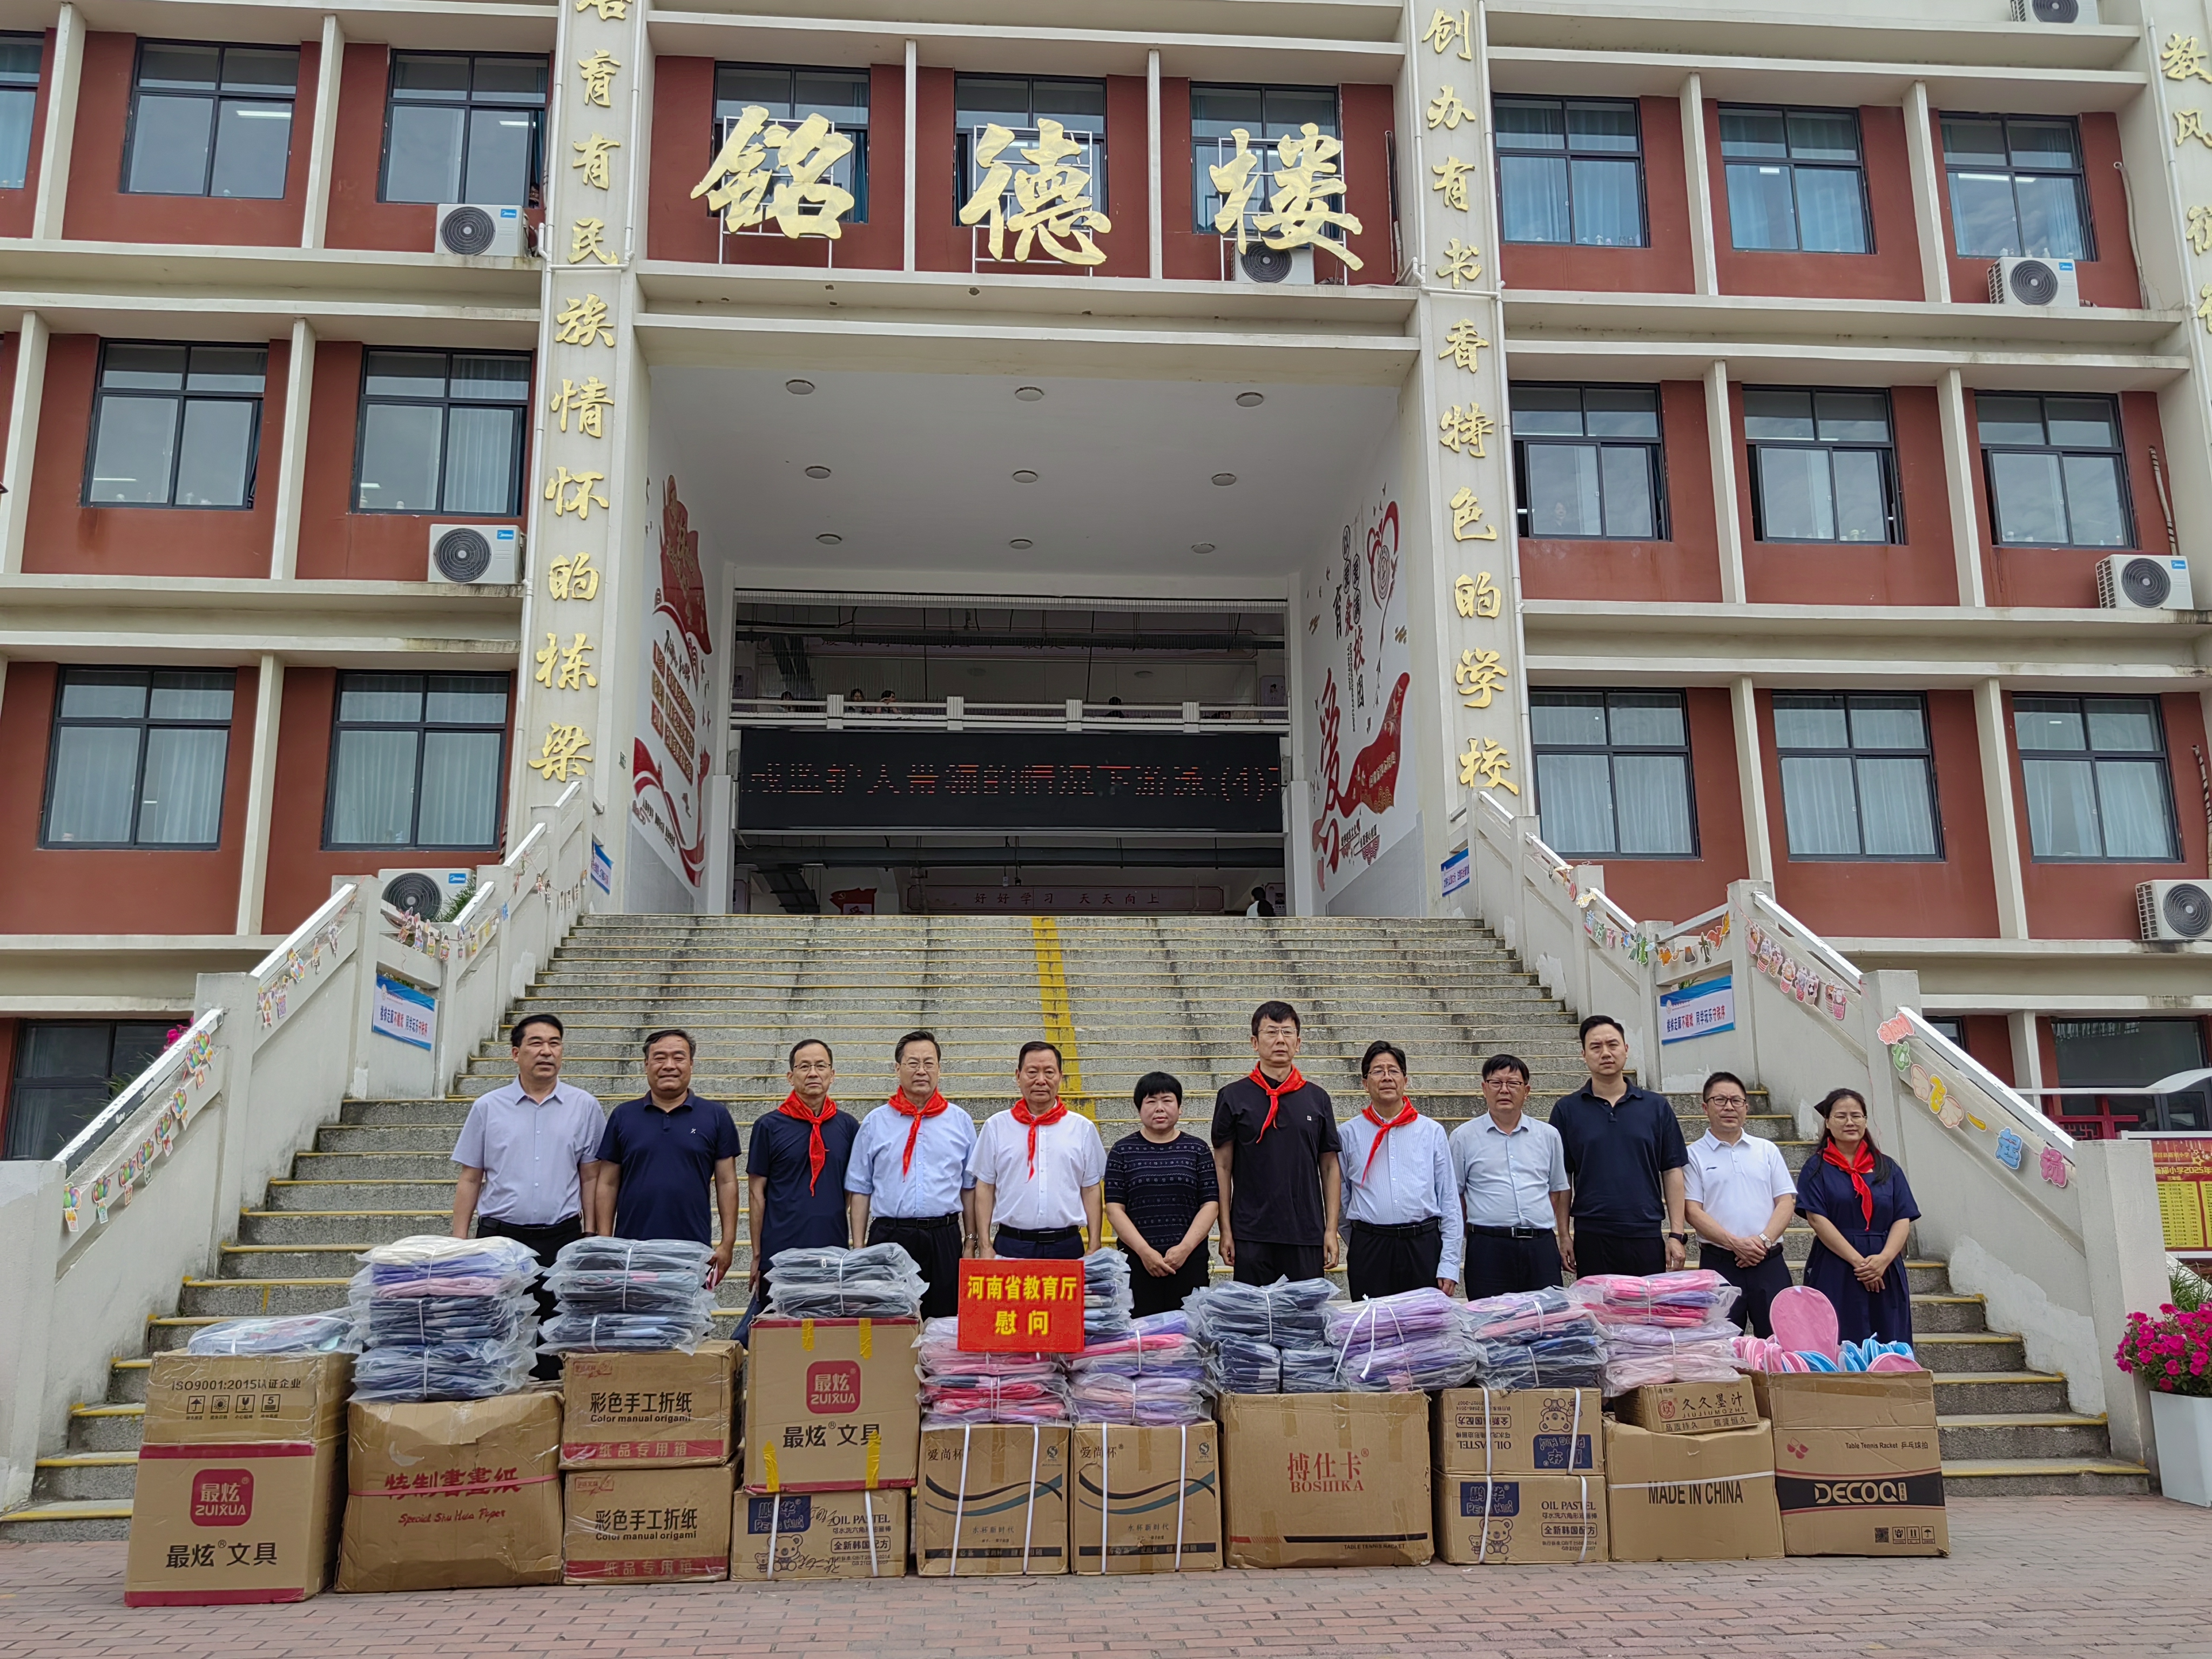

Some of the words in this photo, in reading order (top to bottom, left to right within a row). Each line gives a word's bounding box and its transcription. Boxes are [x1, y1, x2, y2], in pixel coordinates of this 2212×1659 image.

[1422, 8, 1519, 795] 创办有书香特色的学校
[974, 892, 1053, 905] 好好学习
[1080, 893, 1159, 905] 天天向上
[968, 1275, 1077, 1300] 河南省教育厅
[995, 1310, 1050, 1336] 慰问
[172, 1378, 301, 1391] ISO9001:2015认证企业
[590, 1391, 692, 1414] 彩色手工折纸
[1682, 1391, 1743, 1411] 久久墨汁
[590, 1414, 618, 1423] Color
[618, 1414, 652, 1422] manual
[655, 1413, 691, 1424] origami
[1683, 1407, 1744, 1419] JIUJIUMOZHI
[1458, 1416, 1509, 1426] 全新国配方
[598, 1441, 689, 1458] 纸品专用箱
[1458, 1440, 1489, 1450] ASTEL
[1494, 1440, 1512, 1450] OIL
[1901, 1441, 1928, 1449] 乒乓球拍
[927, 1447, 963, 1462] 爱尚杯
[1290, 1480, 1364, 1493] BOSHIKA
[1648, 1482, 1685, 1504] MADE
[1689, 1481, 1702, 1505] IN
[1705, 1480, 1744, 1504] CHINA
[1541, 1501, 1559, 1510] OIL
[1561, 1501, 1596, 1510] PASTEL
[478, 1508, 506, 1522] Paper
[595, 1508, 698, 1531] 彩色手工折纸
[832, 1515, 851, 1526] OIL
[853, 1514, 891, 1524] PATEL
[596, 1532, 620, 1541] Color
[623, 1532, 658, 1540] manual
[660, 1531, 697, 1541] origami
[1544, 1525, 1595, 1535] 全新韩国配方
[604, 1559, 692, 1576] 纸品专用箱
